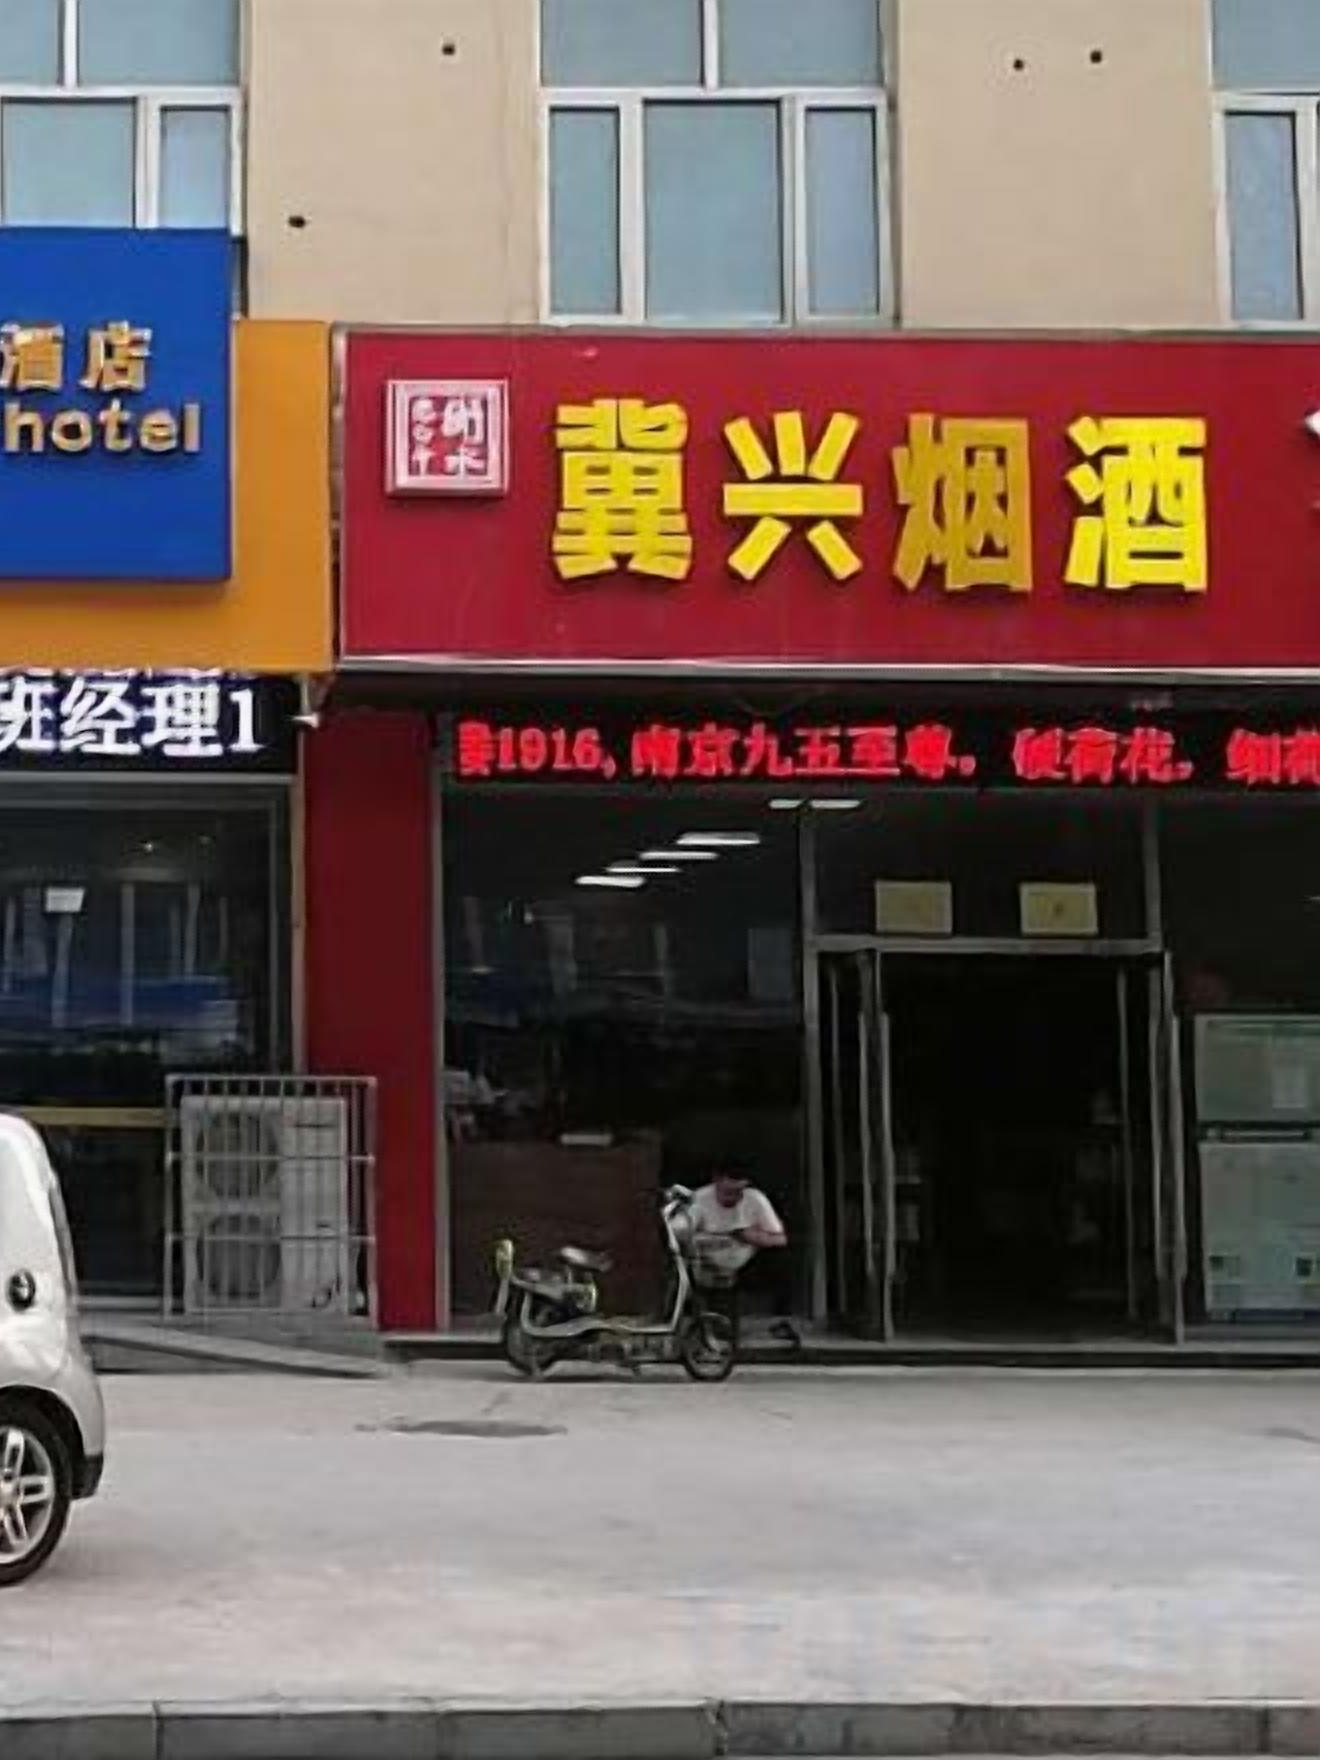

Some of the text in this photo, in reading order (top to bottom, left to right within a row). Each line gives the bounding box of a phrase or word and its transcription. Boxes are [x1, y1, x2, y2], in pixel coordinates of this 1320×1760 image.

[2, 399, 201, 453] hotel
[552, 398, 1207, 592] 冀兴烟酒
